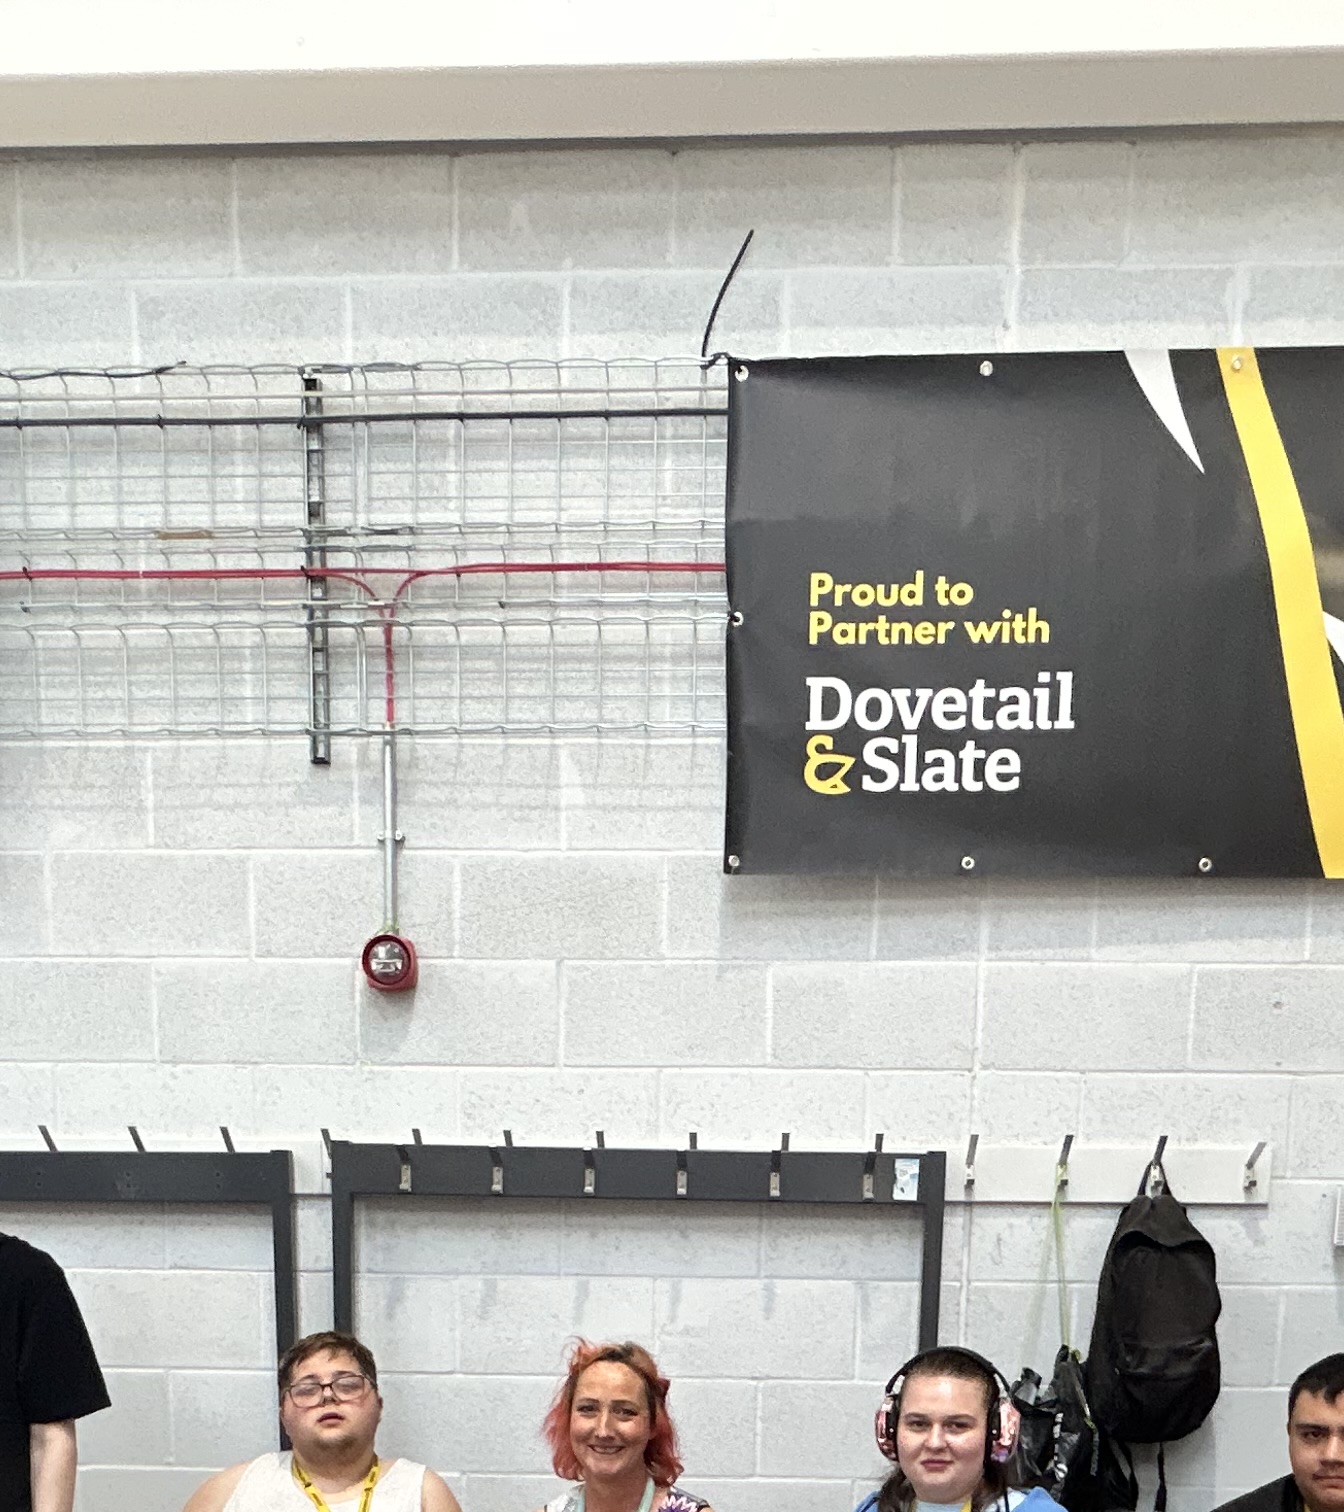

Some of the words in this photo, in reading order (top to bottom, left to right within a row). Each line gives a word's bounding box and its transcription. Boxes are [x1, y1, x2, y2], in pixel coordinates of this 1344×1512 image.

[809, 569, 925, 607] Proud
[934, 575, 975, 606] to
[808, 610, 956, 646] Partner
[963, 607, 1051, 645] with
[804, 670, 1076, 731] Dovetail
[803, 734, 857, 796] &
[860, 733, 1022, 793] Slate
